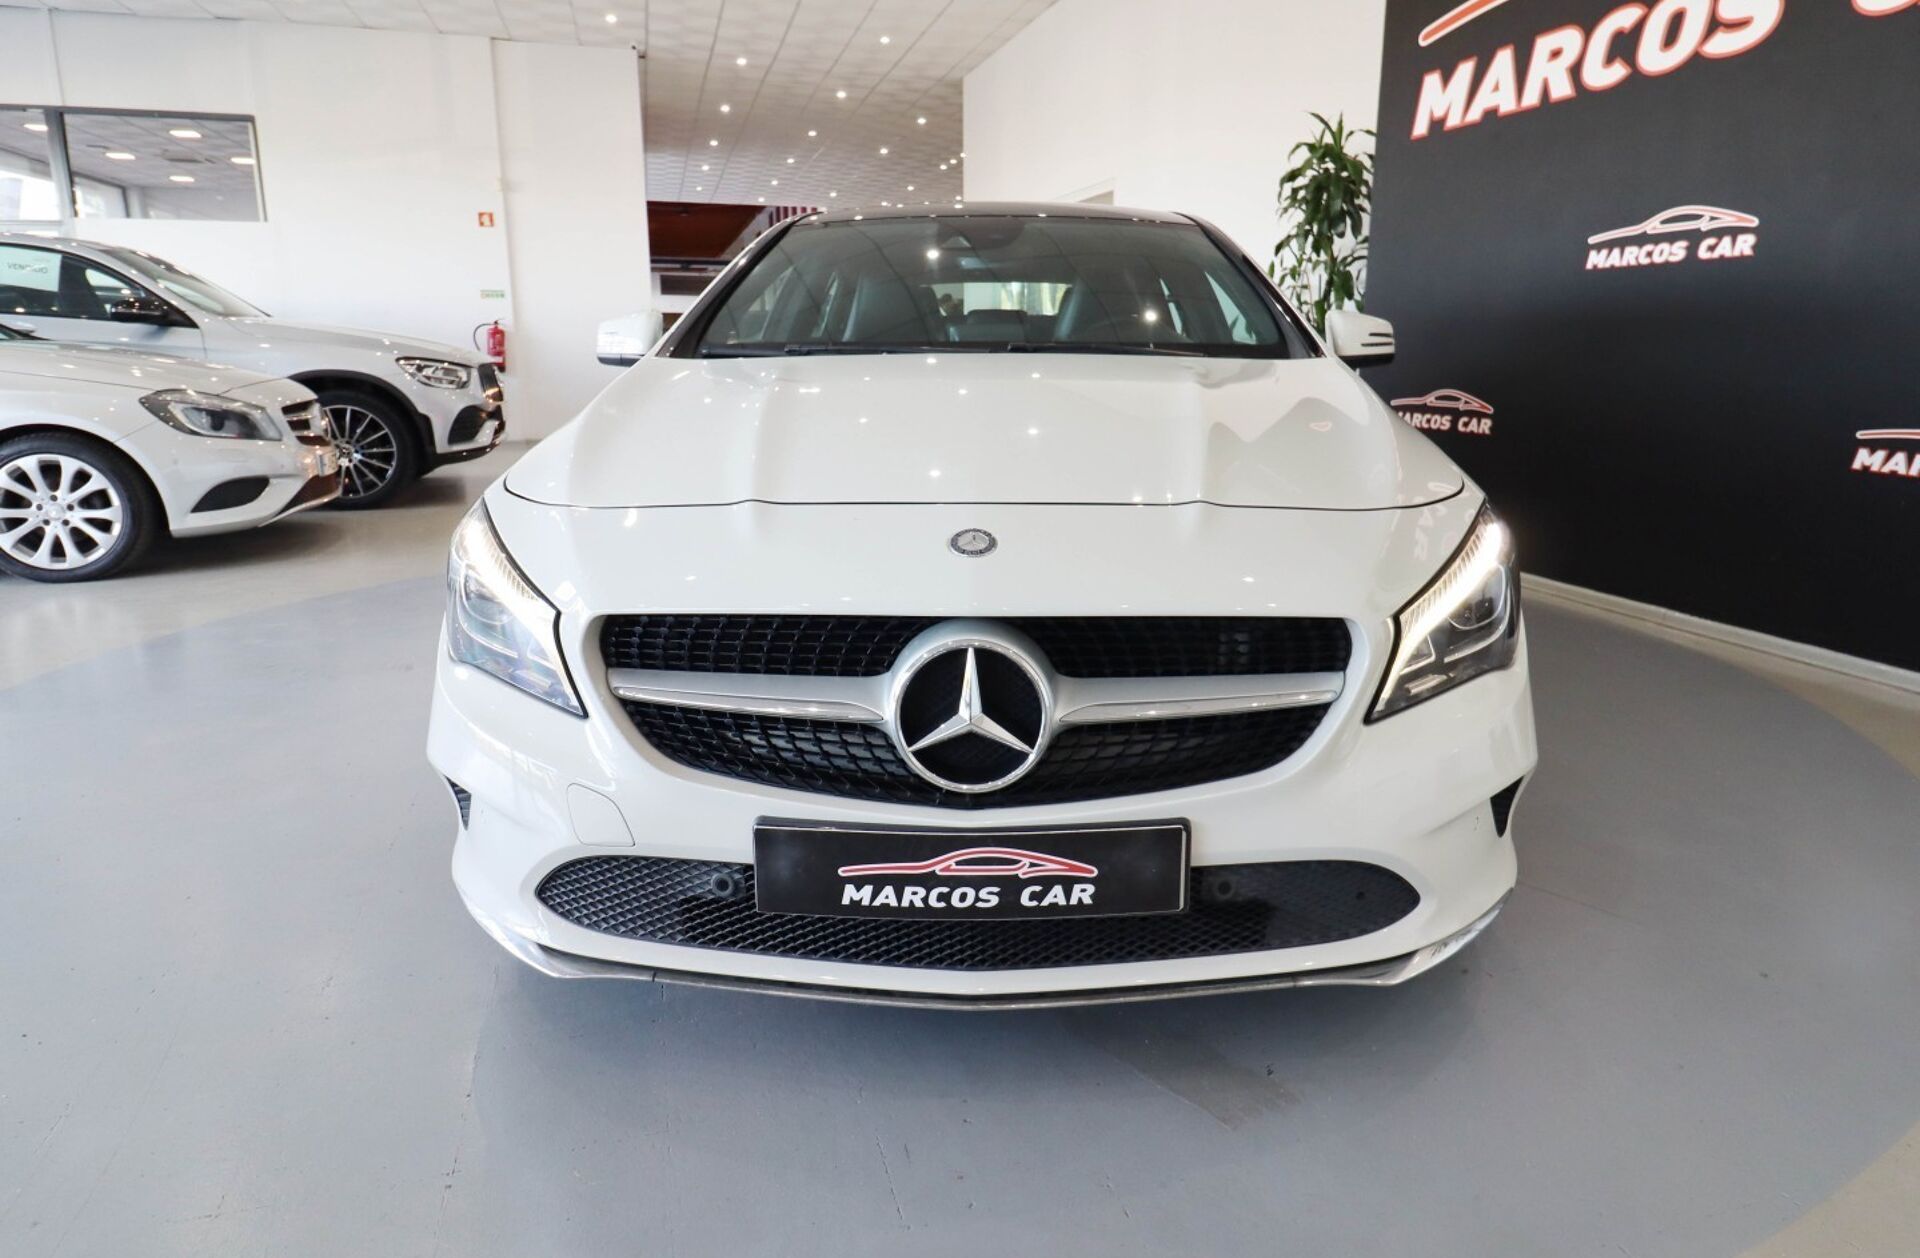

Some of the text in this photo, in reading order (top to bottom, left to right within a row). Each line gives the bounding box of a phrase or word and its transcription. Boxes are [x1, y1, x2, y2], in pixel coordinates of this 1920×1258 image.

[1411, 0, 1785, 139] MARCOS
[1585, 233, 1757, 270] MARCOS CAR
[7, 261, 49, 274] VENDO
[1398, 411, 1493, 434] ARCOS CAR
[841, 883, 1096, 909] MARCOS CAR
